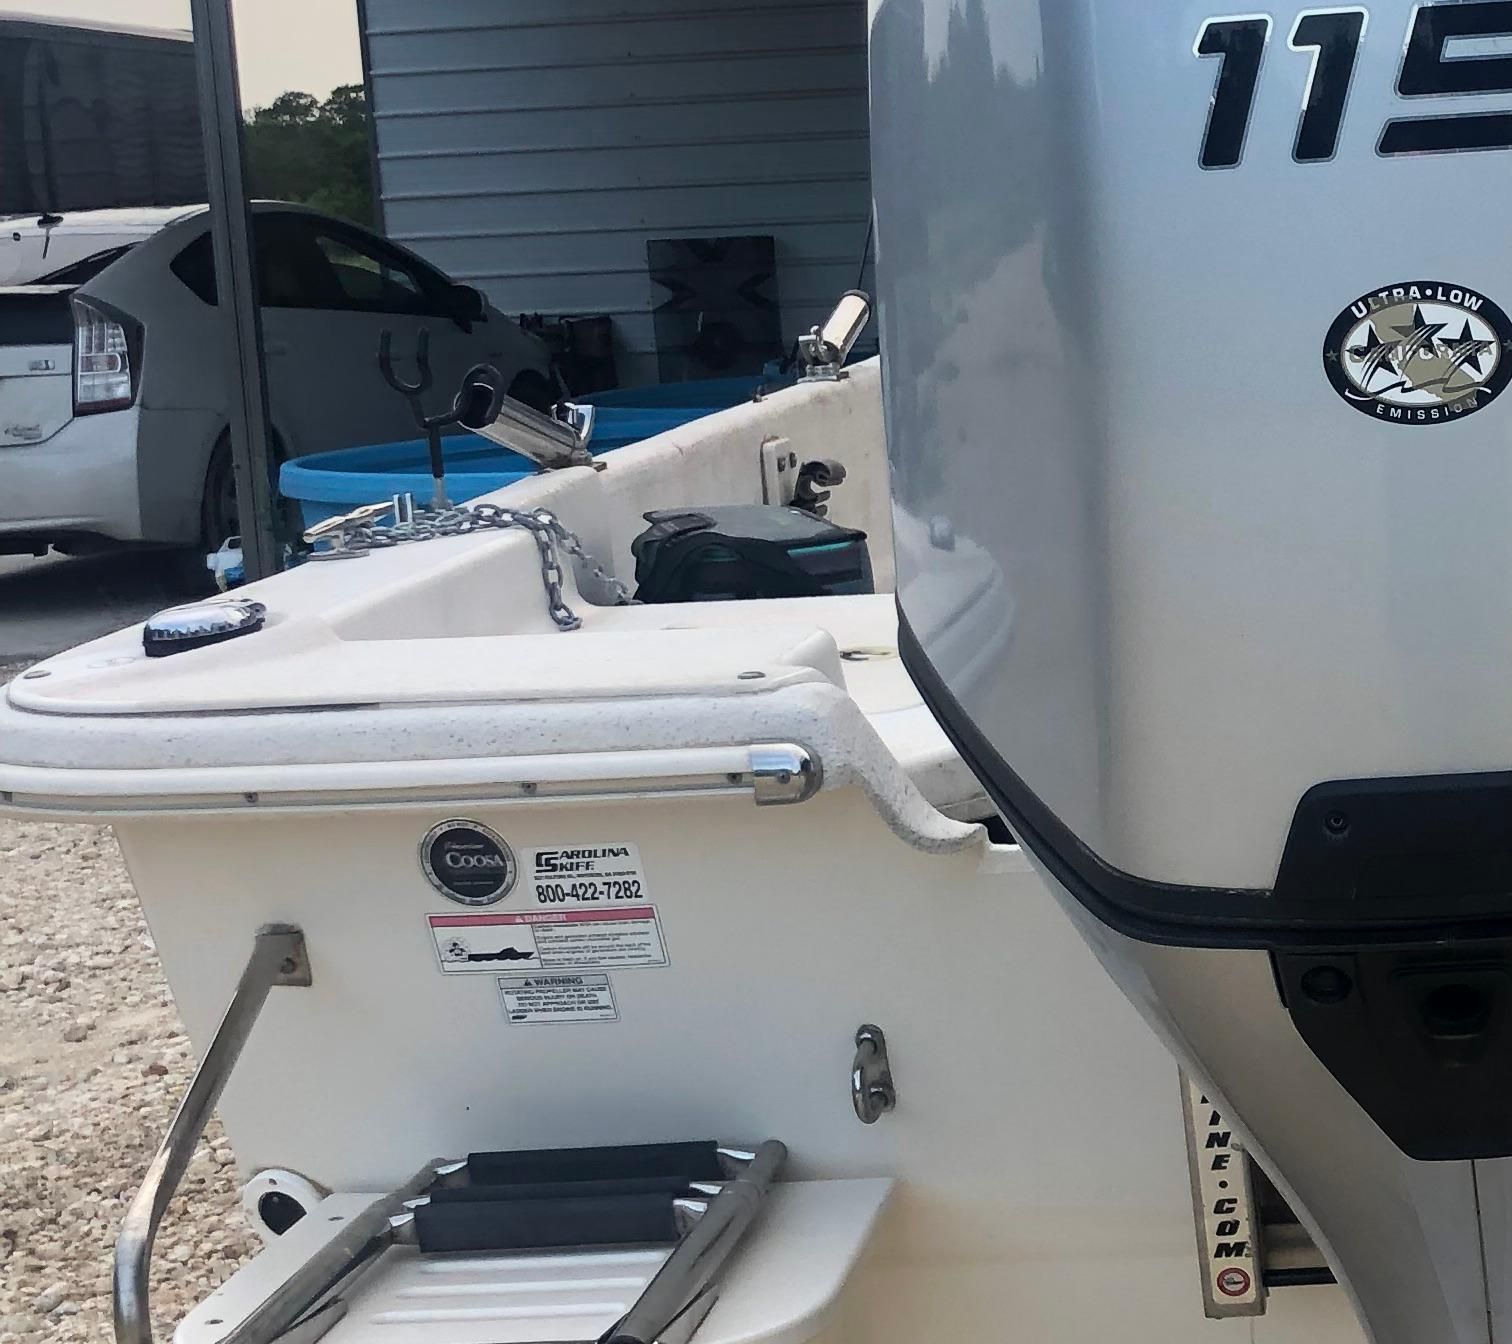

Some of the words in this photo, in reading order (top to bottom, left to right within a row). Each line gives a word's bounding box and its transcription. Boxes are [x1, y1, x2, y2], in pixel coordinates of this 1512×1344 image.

[1376, 395, 1478, 420] EMISSION
[536, 879, 643, 904] 800-422-7282
[533, 976, 584, 986] WARNING
